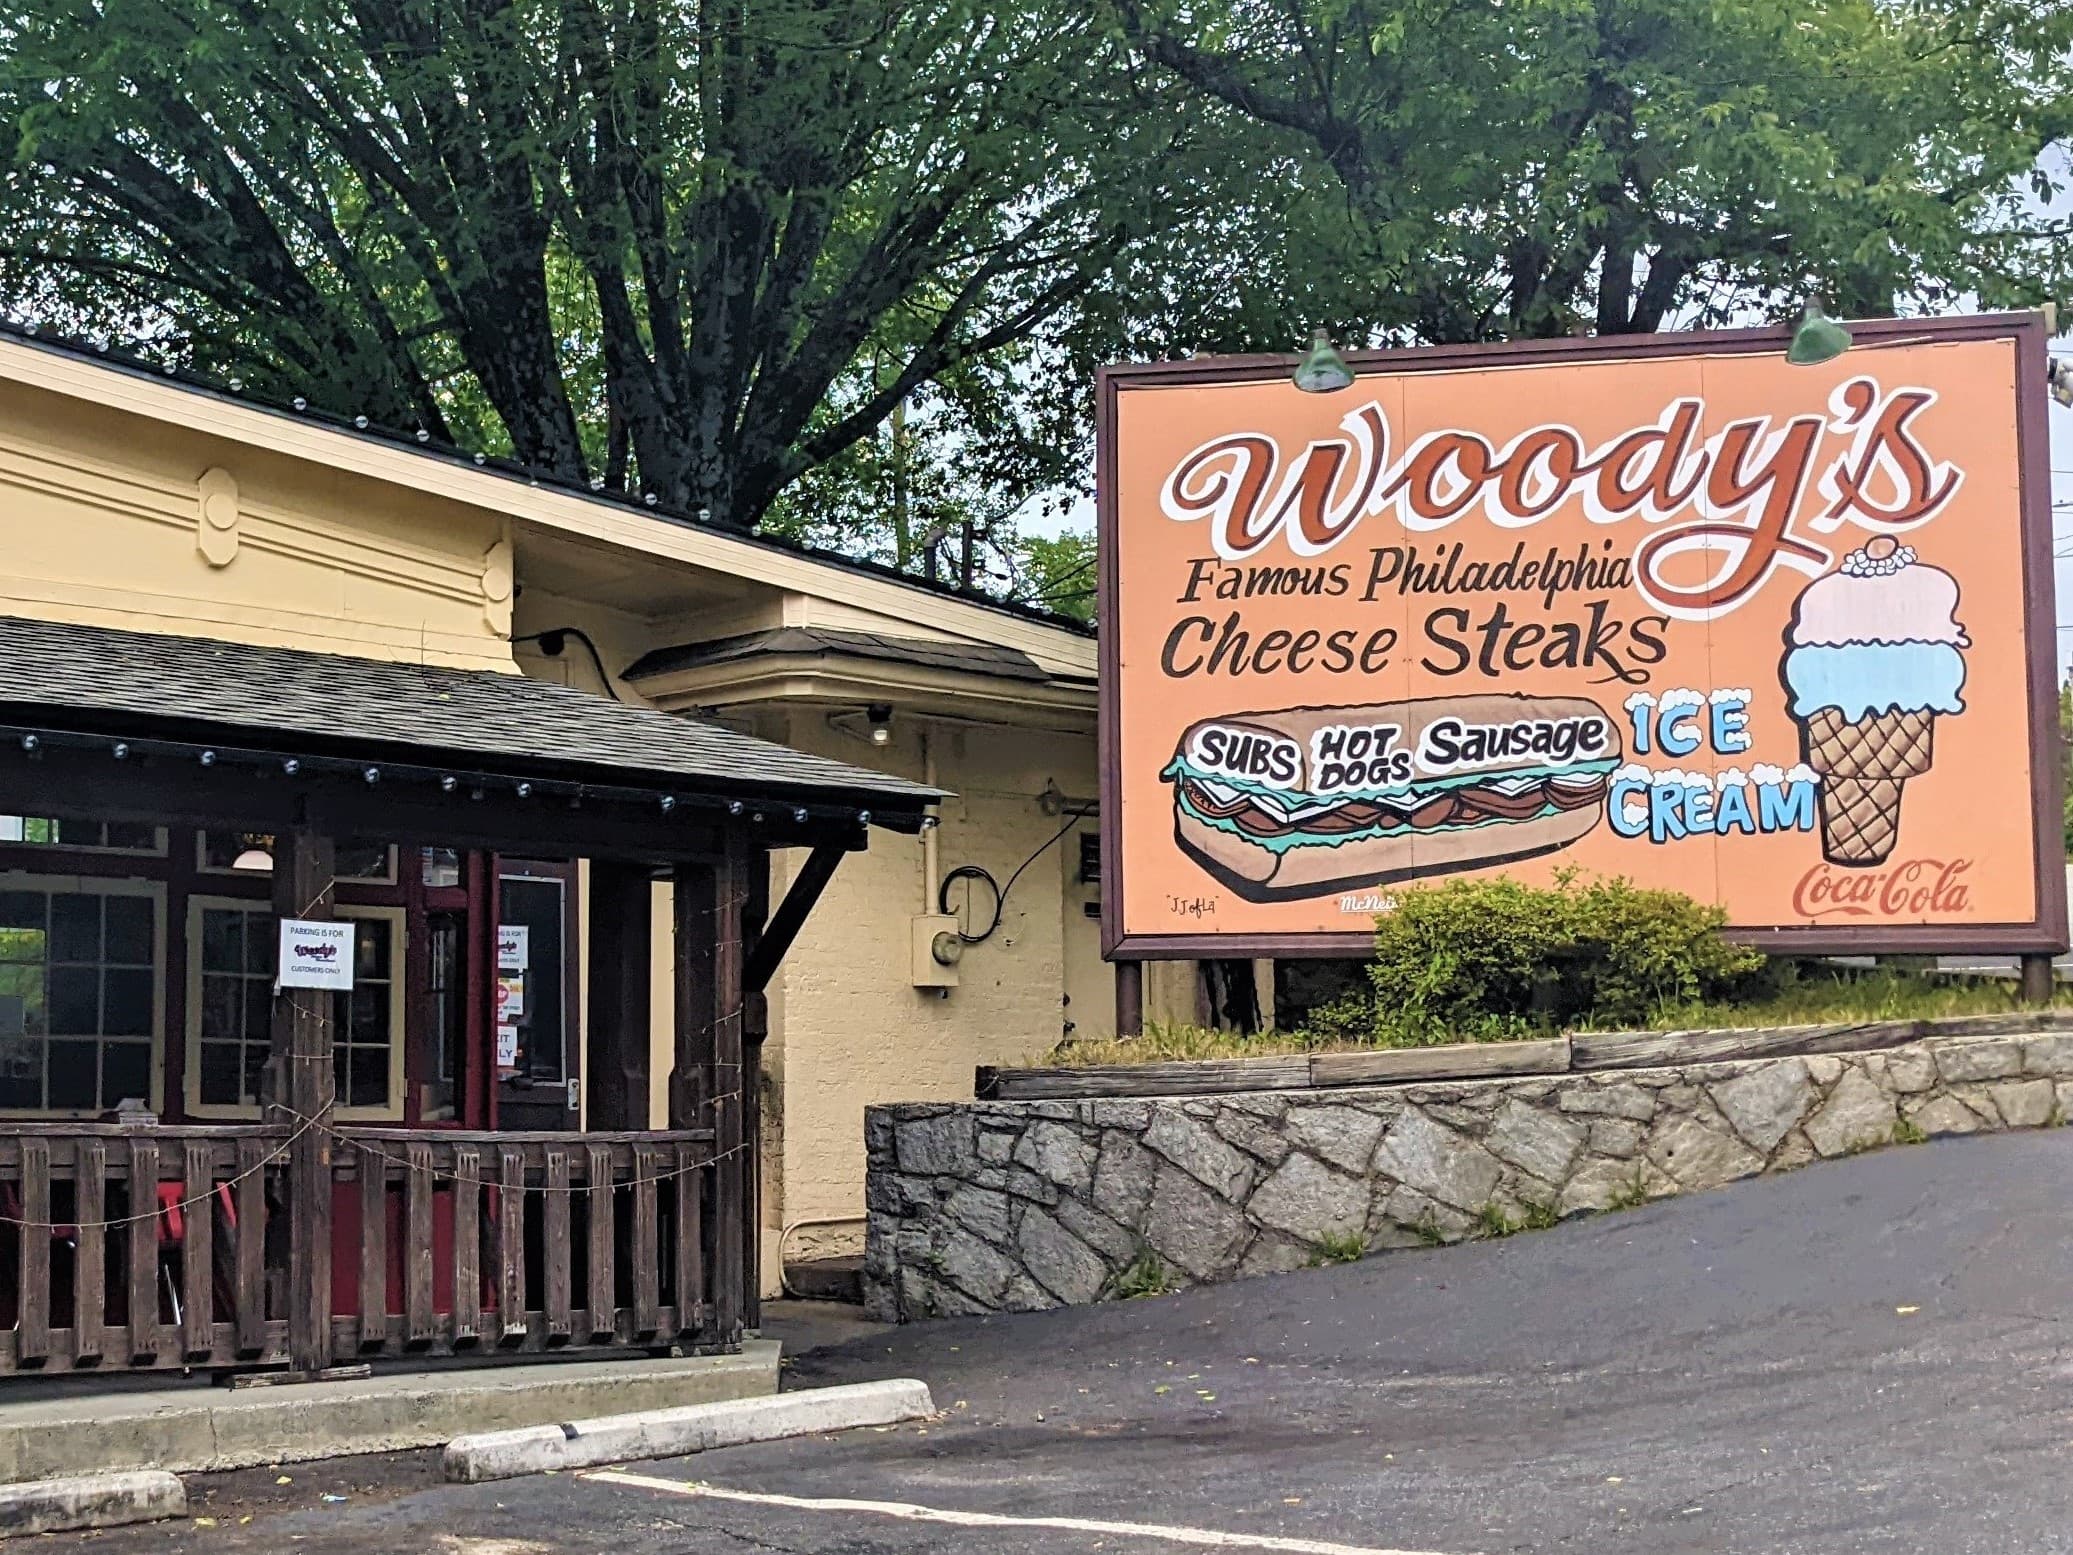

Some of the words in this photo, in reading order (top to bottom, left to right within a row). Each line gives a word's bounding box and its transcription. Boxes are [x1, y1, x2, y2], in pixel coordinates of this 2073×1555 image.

[1162, 376, 1966, 620] Woody's
[1176, 556, 1350, 604] Famous
[1367, 541, 1634, 609] Philadelphia
[1161, 613, 1398, 679] Cheese
[1421, 601, 1670, 686] Steaks
[1318, 727, 1396, 760] HOT
[1424, 719, 1606, 766] Sausage
[1623, 687, 1753, 757] ICE
[1200, 729, 1296, 781] SUBS
[1318, 752, 1412, 791] DOGS
[1608, 763, 1822, 844] CREAM
[1792, 858, 1974, 918] Coca-Cola
[290, 926, 320, 937] PARKING
[329, 929, 344, 938] FOR
